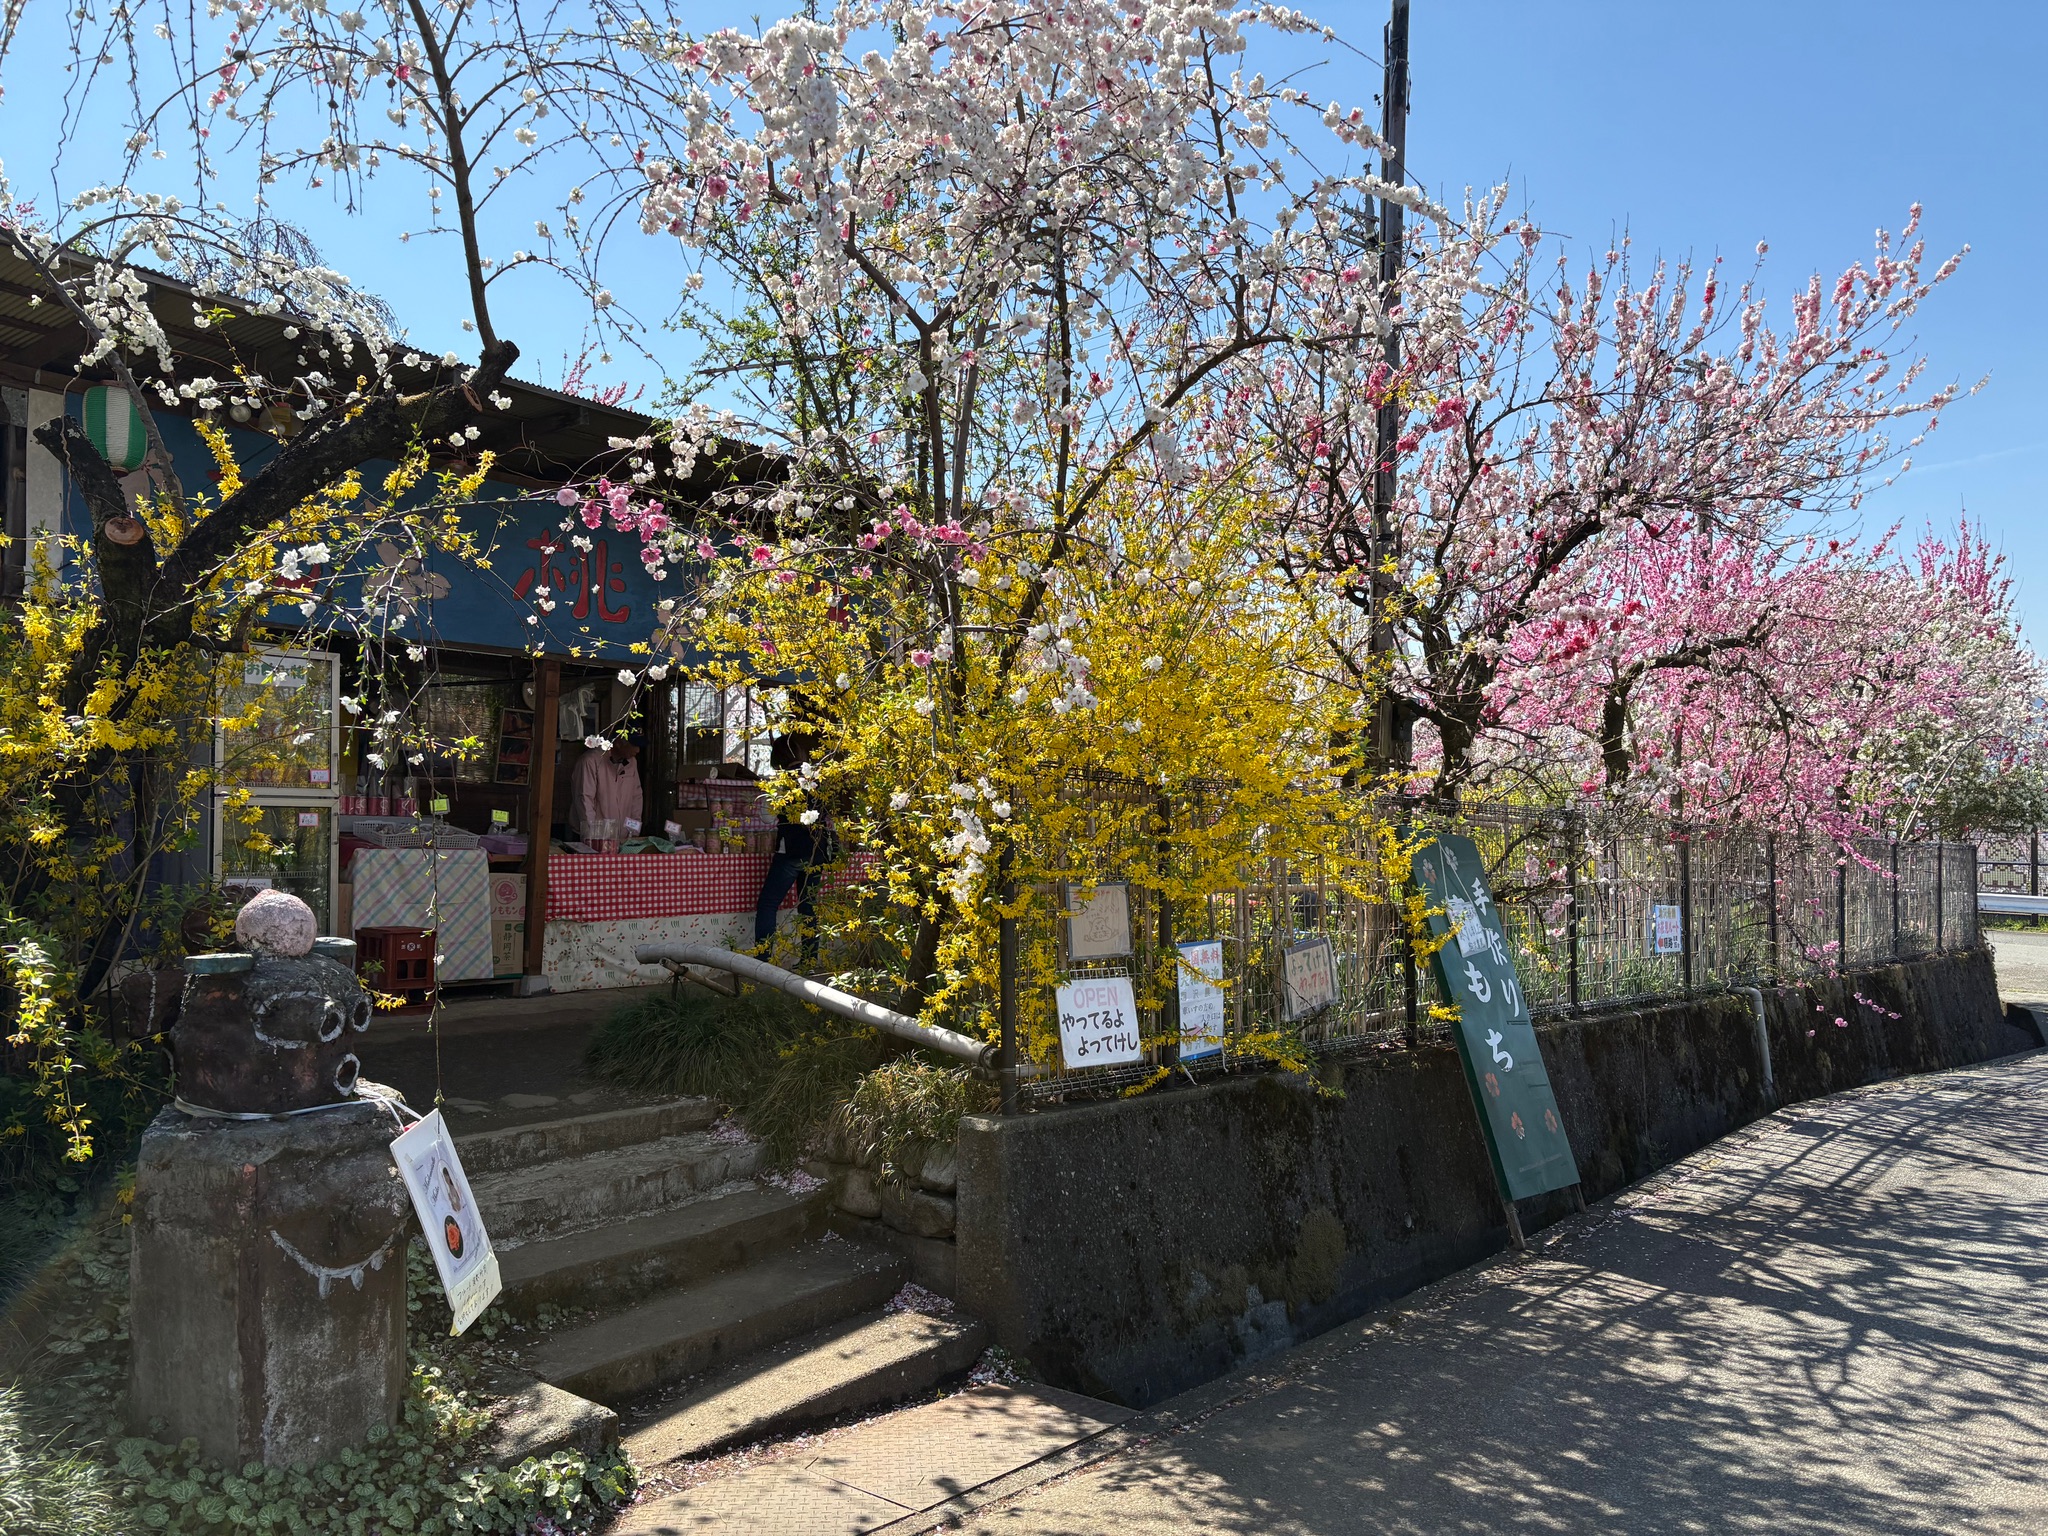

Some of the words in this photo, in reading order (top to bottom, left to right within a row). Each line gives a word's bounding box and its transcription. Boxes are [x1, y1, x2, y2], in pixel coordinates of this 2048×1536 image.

[1073, 986, 1119, 1009] OPEN
[1061, 1008, 1125, 1033] やってるよ
[1077, 1032, 1138, 1057] よってけし
